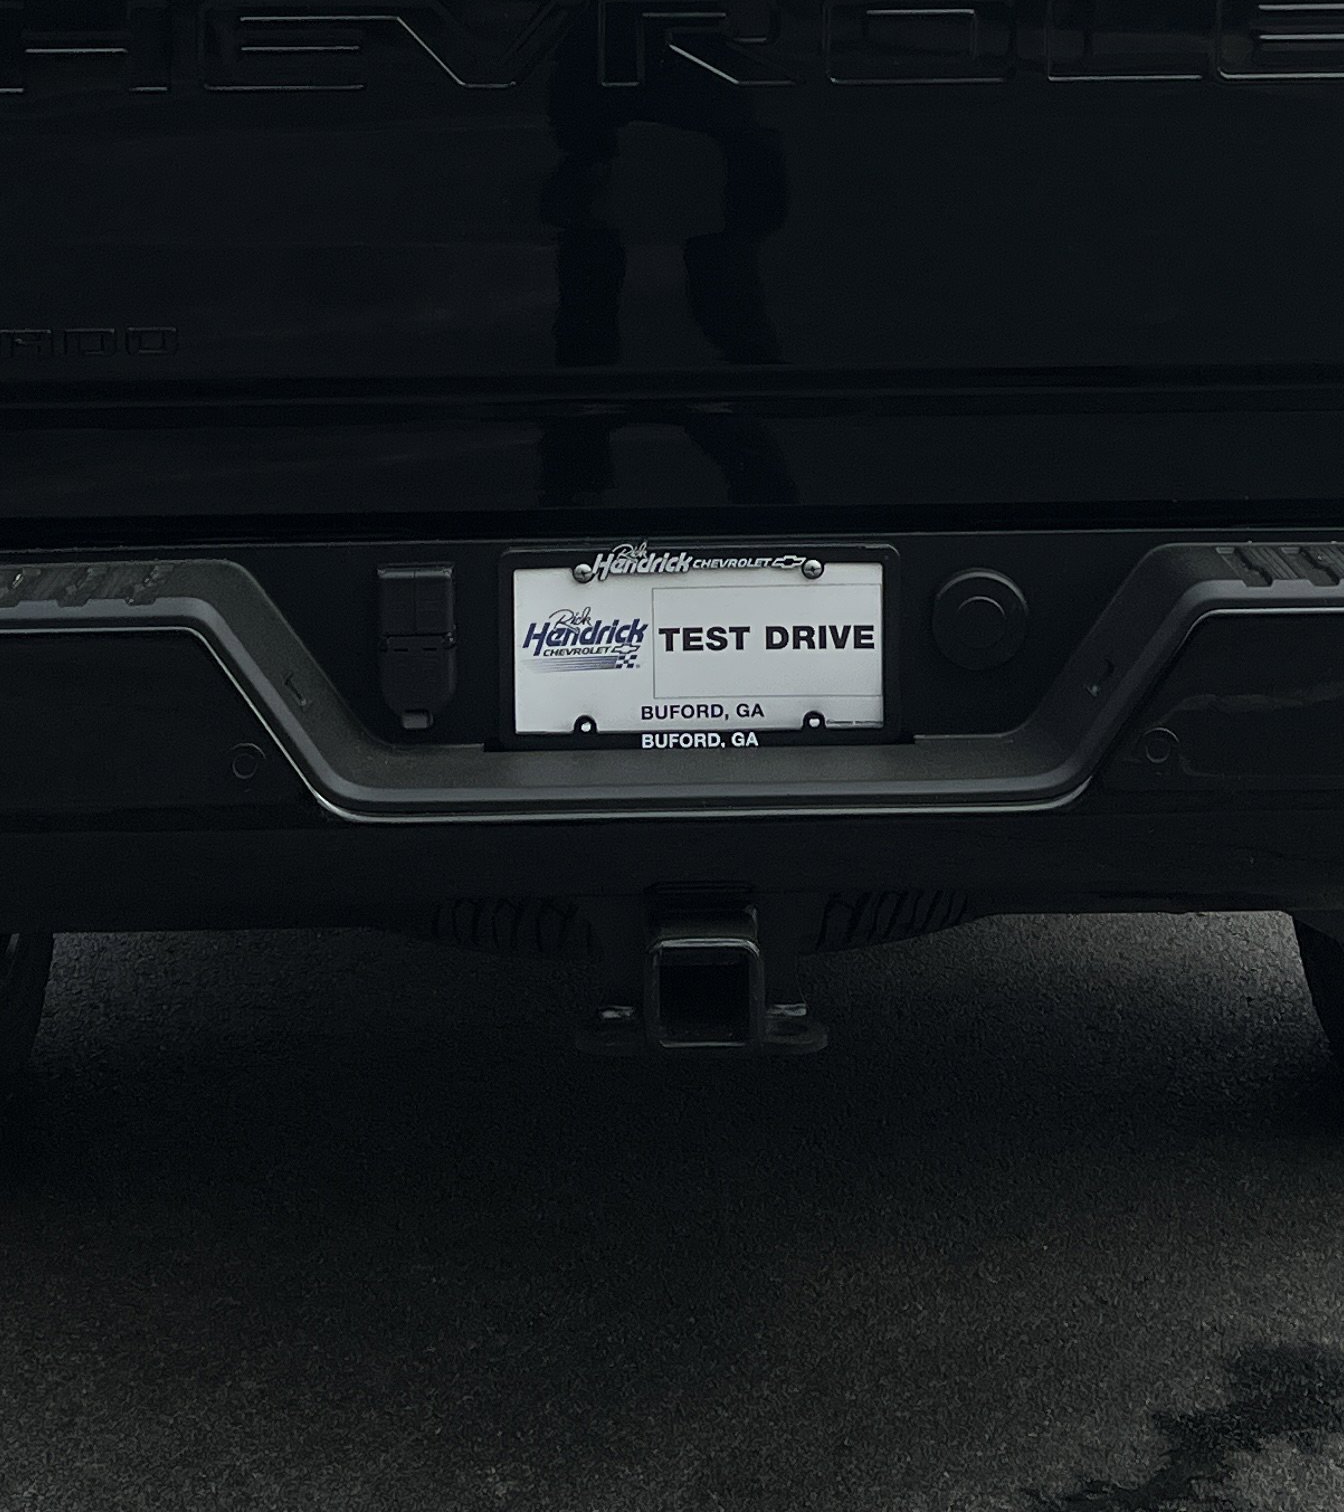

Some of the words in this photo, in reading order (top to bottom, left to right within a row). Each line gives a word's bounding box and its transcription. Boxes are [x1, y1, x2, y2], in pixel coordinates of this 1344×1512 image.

[612, 540, 648, 560] Rick
[592, 552, 693, 580] Hendrick
[692, 557, 773, 569] CHEVROLET
[548, 606, 593, 630] Rick
[522, 618, 649, 656] Hendrick
[658, 625, 751, 652] TEST
[765, 624, 875, 650] DRIVE
[543, 645, 613, 657] CHEVROLET
[641, 704, 729, 721] BUFORD,
[736, 703, 765, 719] GA
[731, 732, 759, 747] GA
